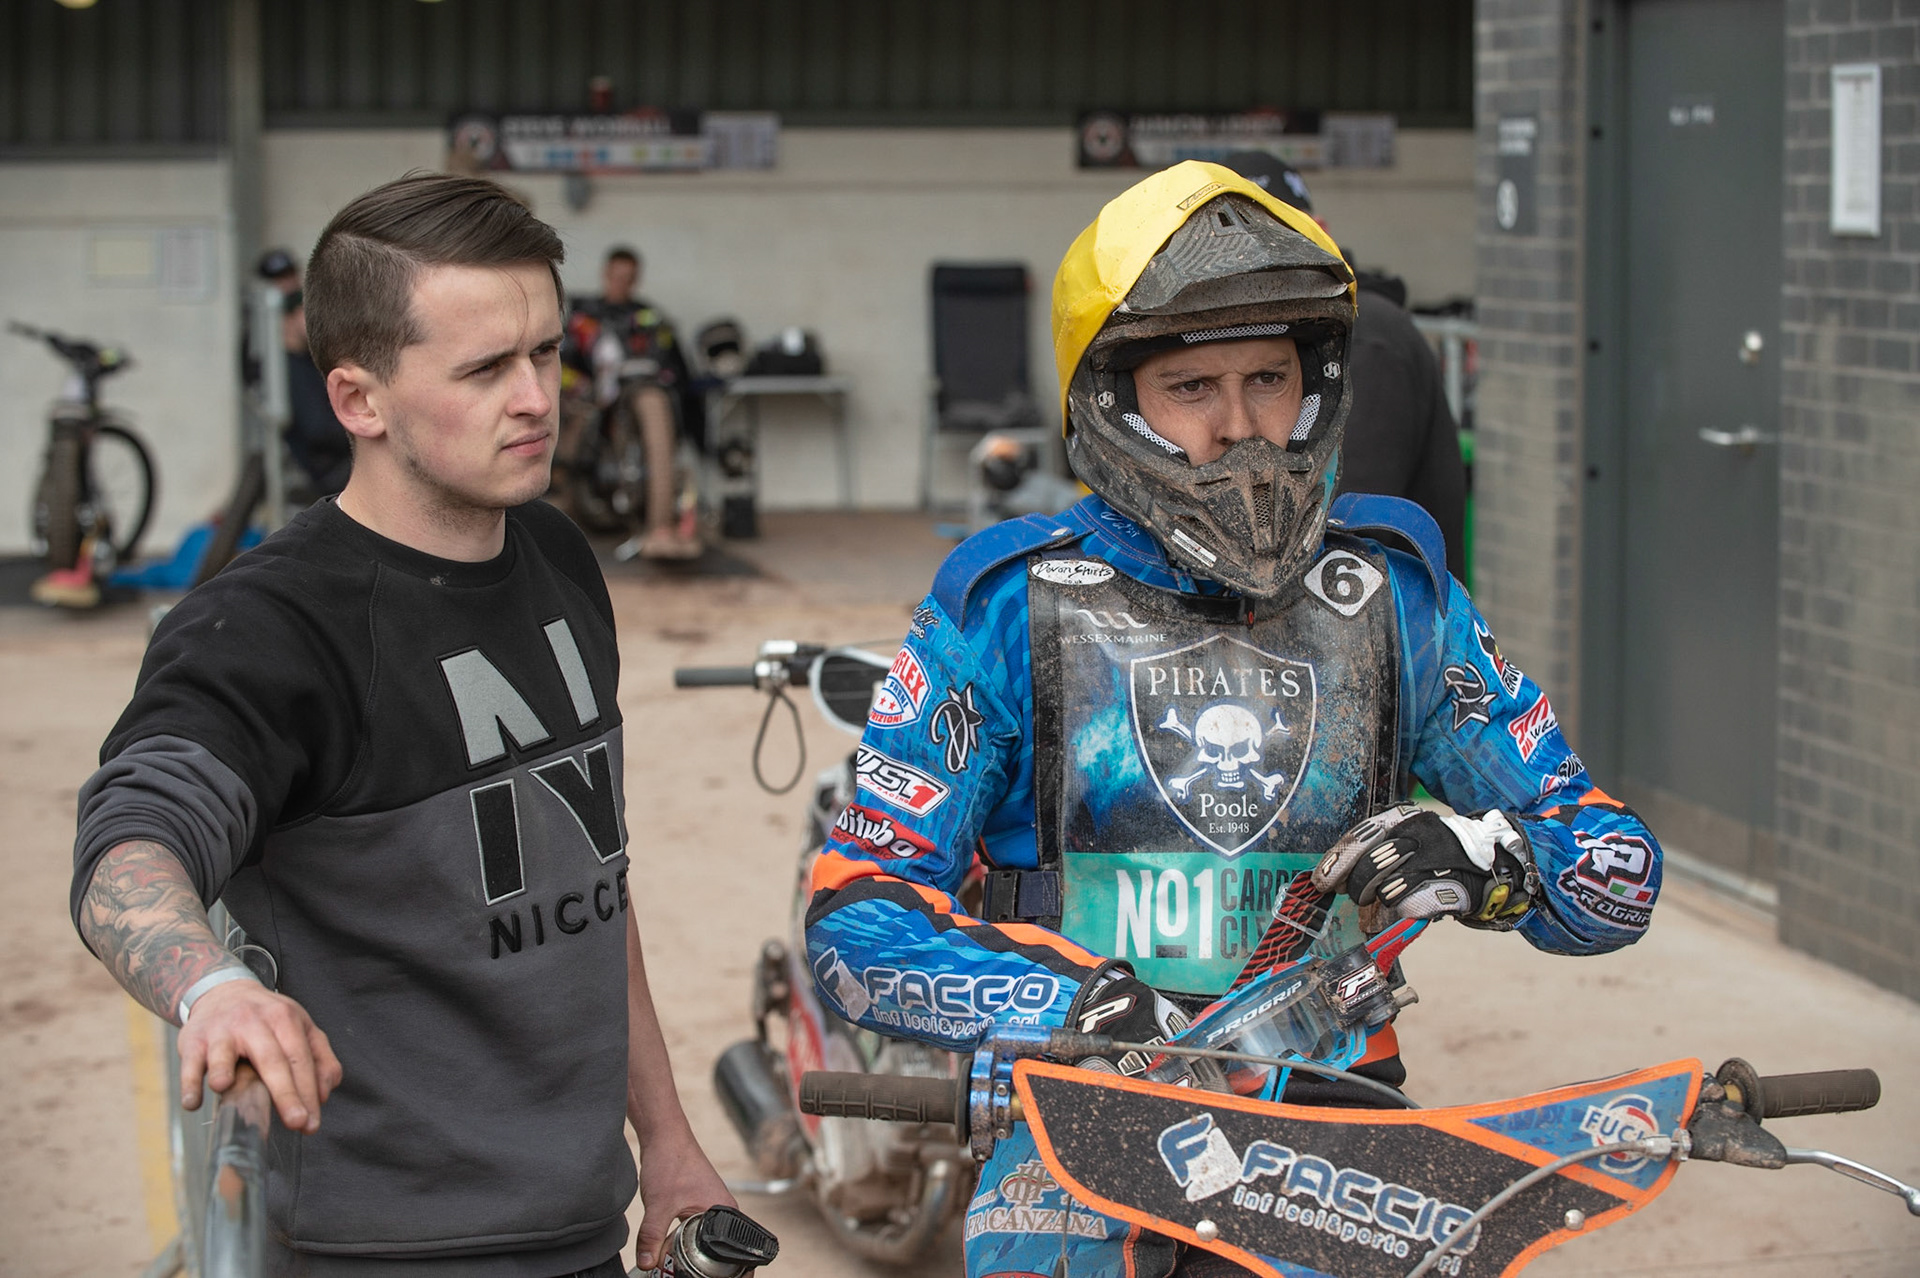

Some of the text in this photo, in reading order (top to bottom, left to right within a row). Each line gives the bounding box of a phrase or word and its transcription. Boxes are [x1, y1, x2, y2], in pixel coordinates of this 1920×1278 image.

[1321, 557, 1367, 605] 6
[1148, 667, 1301, 697] PIRATES
[857, 748, 944, 809] UST1
[1199, 793, 1258, 818] Poole
[1209, 822, 1250, 834] Est. 1948
[1221, 868, 1303, 912] CARP
[489, 867, 629, 959] NICCE
[1206, 981, 1302, 1043] PROGRIP
[1585, 1110, 1645, 1142] FUC
